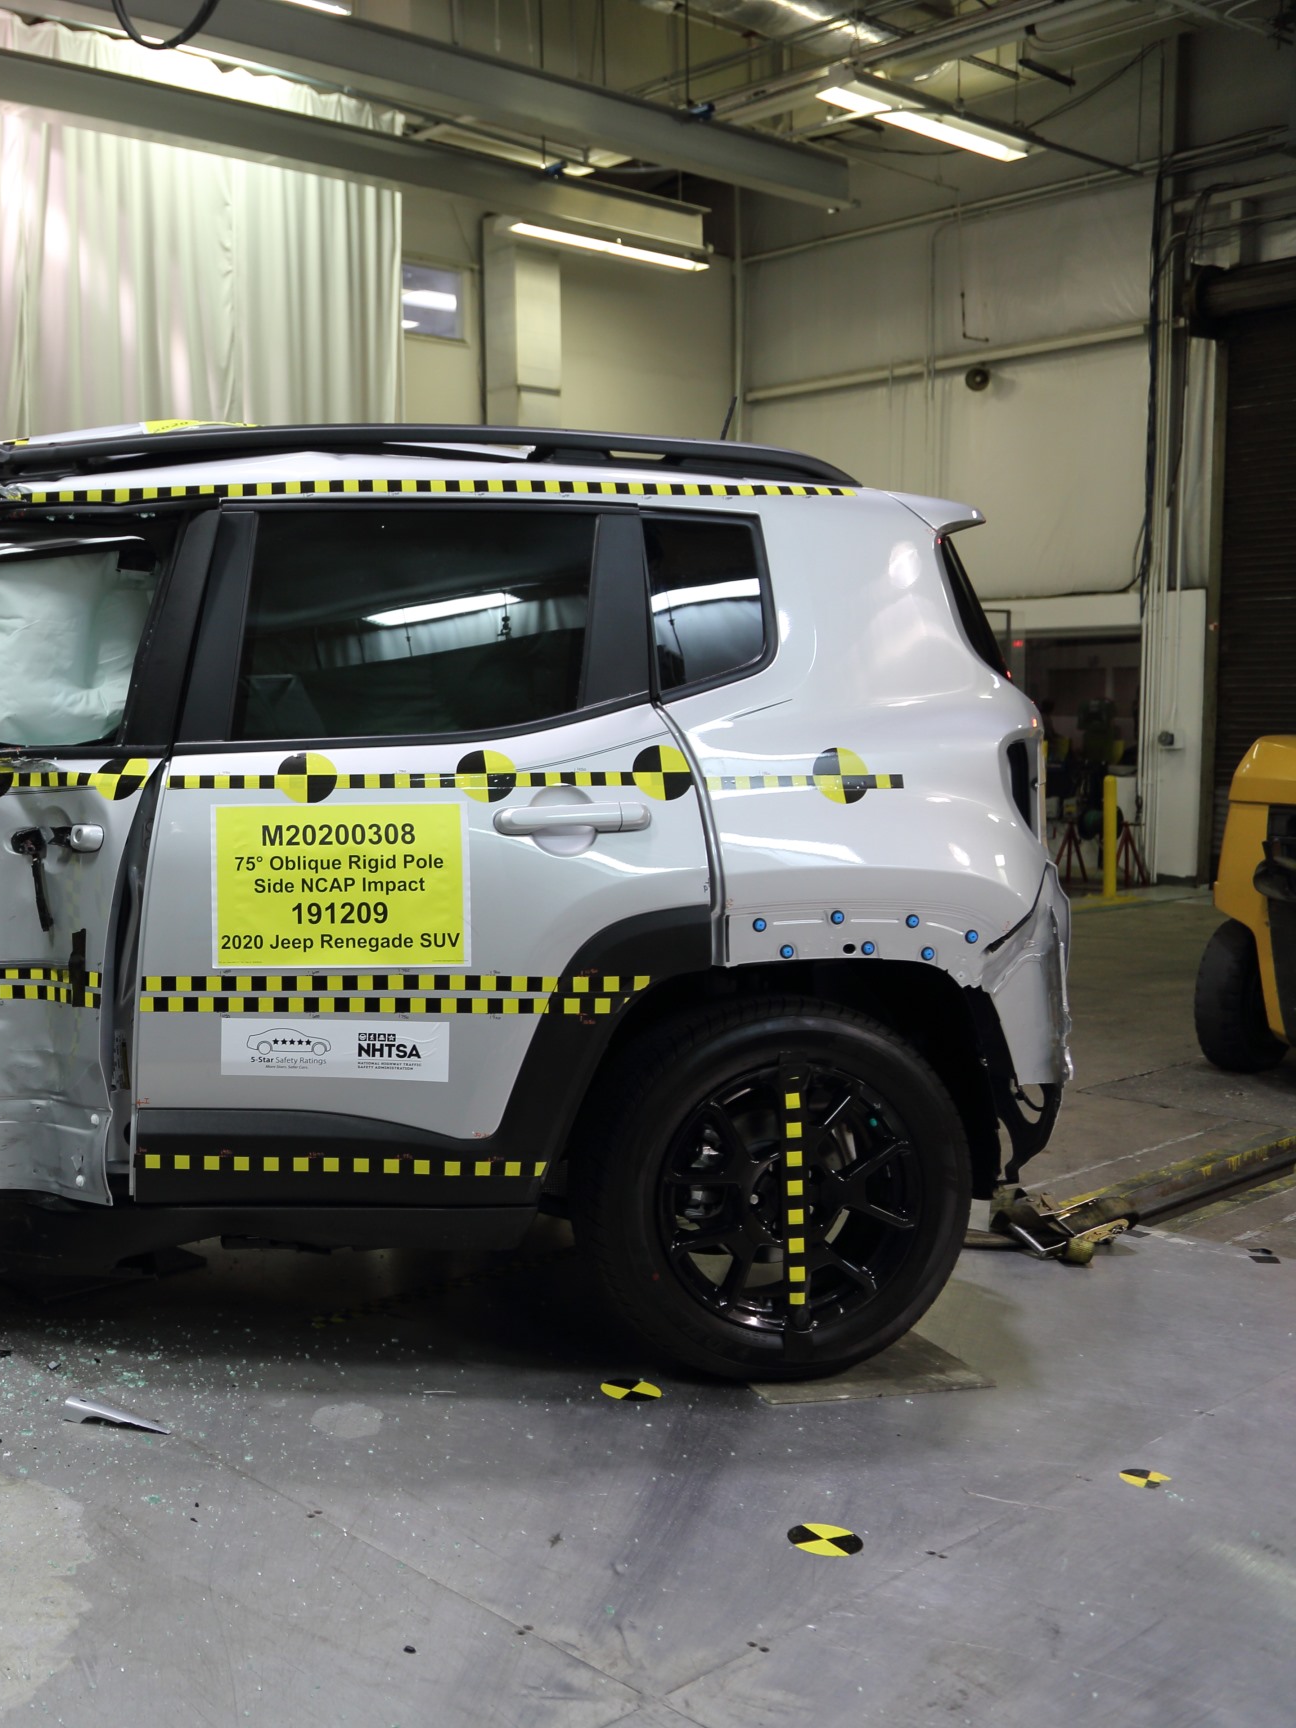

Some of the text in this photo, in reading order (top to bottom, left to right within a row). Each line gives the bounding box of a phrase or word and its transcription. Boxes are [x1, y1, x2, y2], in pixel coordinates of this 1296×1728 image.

[262, 823, 415, 846] M20200308
[235, 854, 444, 873] 75° Oblique Rigid Pole
[254, 877, 425, 895] Side NCAP Impact
[292, 902, 388, 924] 191209
[221, 933, 460, 952] 2020 Jeep Renegade SUV
[358, 1043, 421, 1058] NHTSA
[275, 1057, 298, 1065] Safety
[300, 1057, 327, 1065] Ratings
